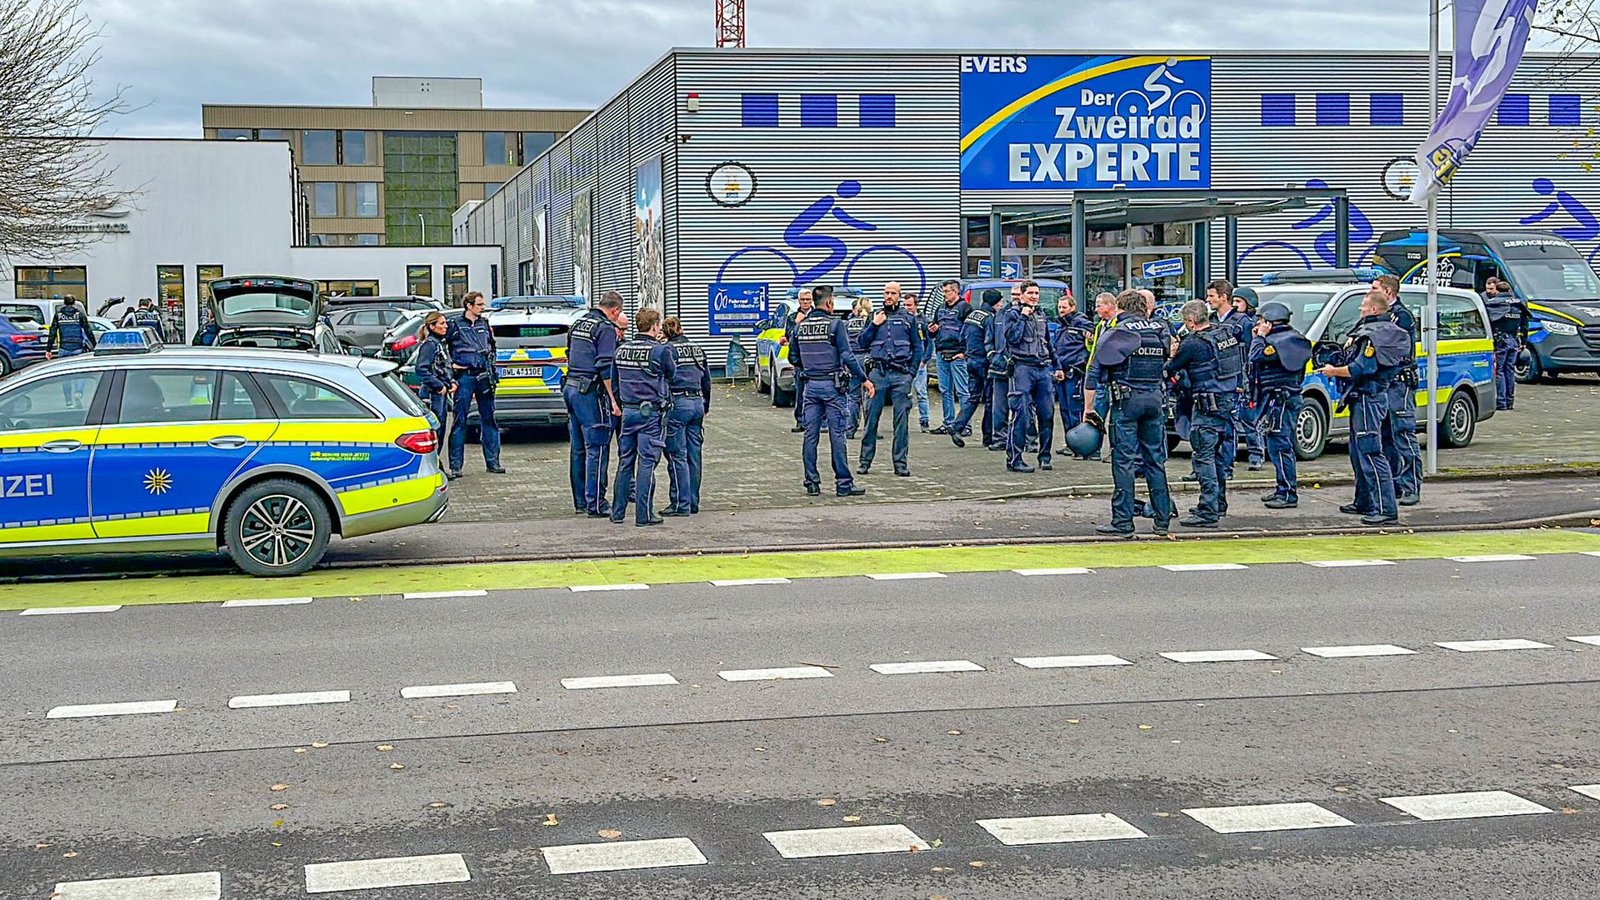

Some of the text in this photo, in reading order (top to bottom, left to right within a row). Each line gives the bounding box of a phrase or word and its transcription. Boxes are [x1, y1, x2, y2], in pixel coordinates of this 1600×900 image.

[961, 57, 1027, 73] EVERS
[1081, 89, 1115, 106] Der
[1054, 104, 1201, 139] Zweirad
[1009, 143, 1200, 182] EXPERTE
[1420, 266, 1453, 278] Zirad
[1412, 277, 1452, 287] EXPRTE
[798, 325, 828, 336] POLIZEI
[616, 348, 650, 361] POLIZEI
[1132, 347, 1163, 356] OLIZEI
